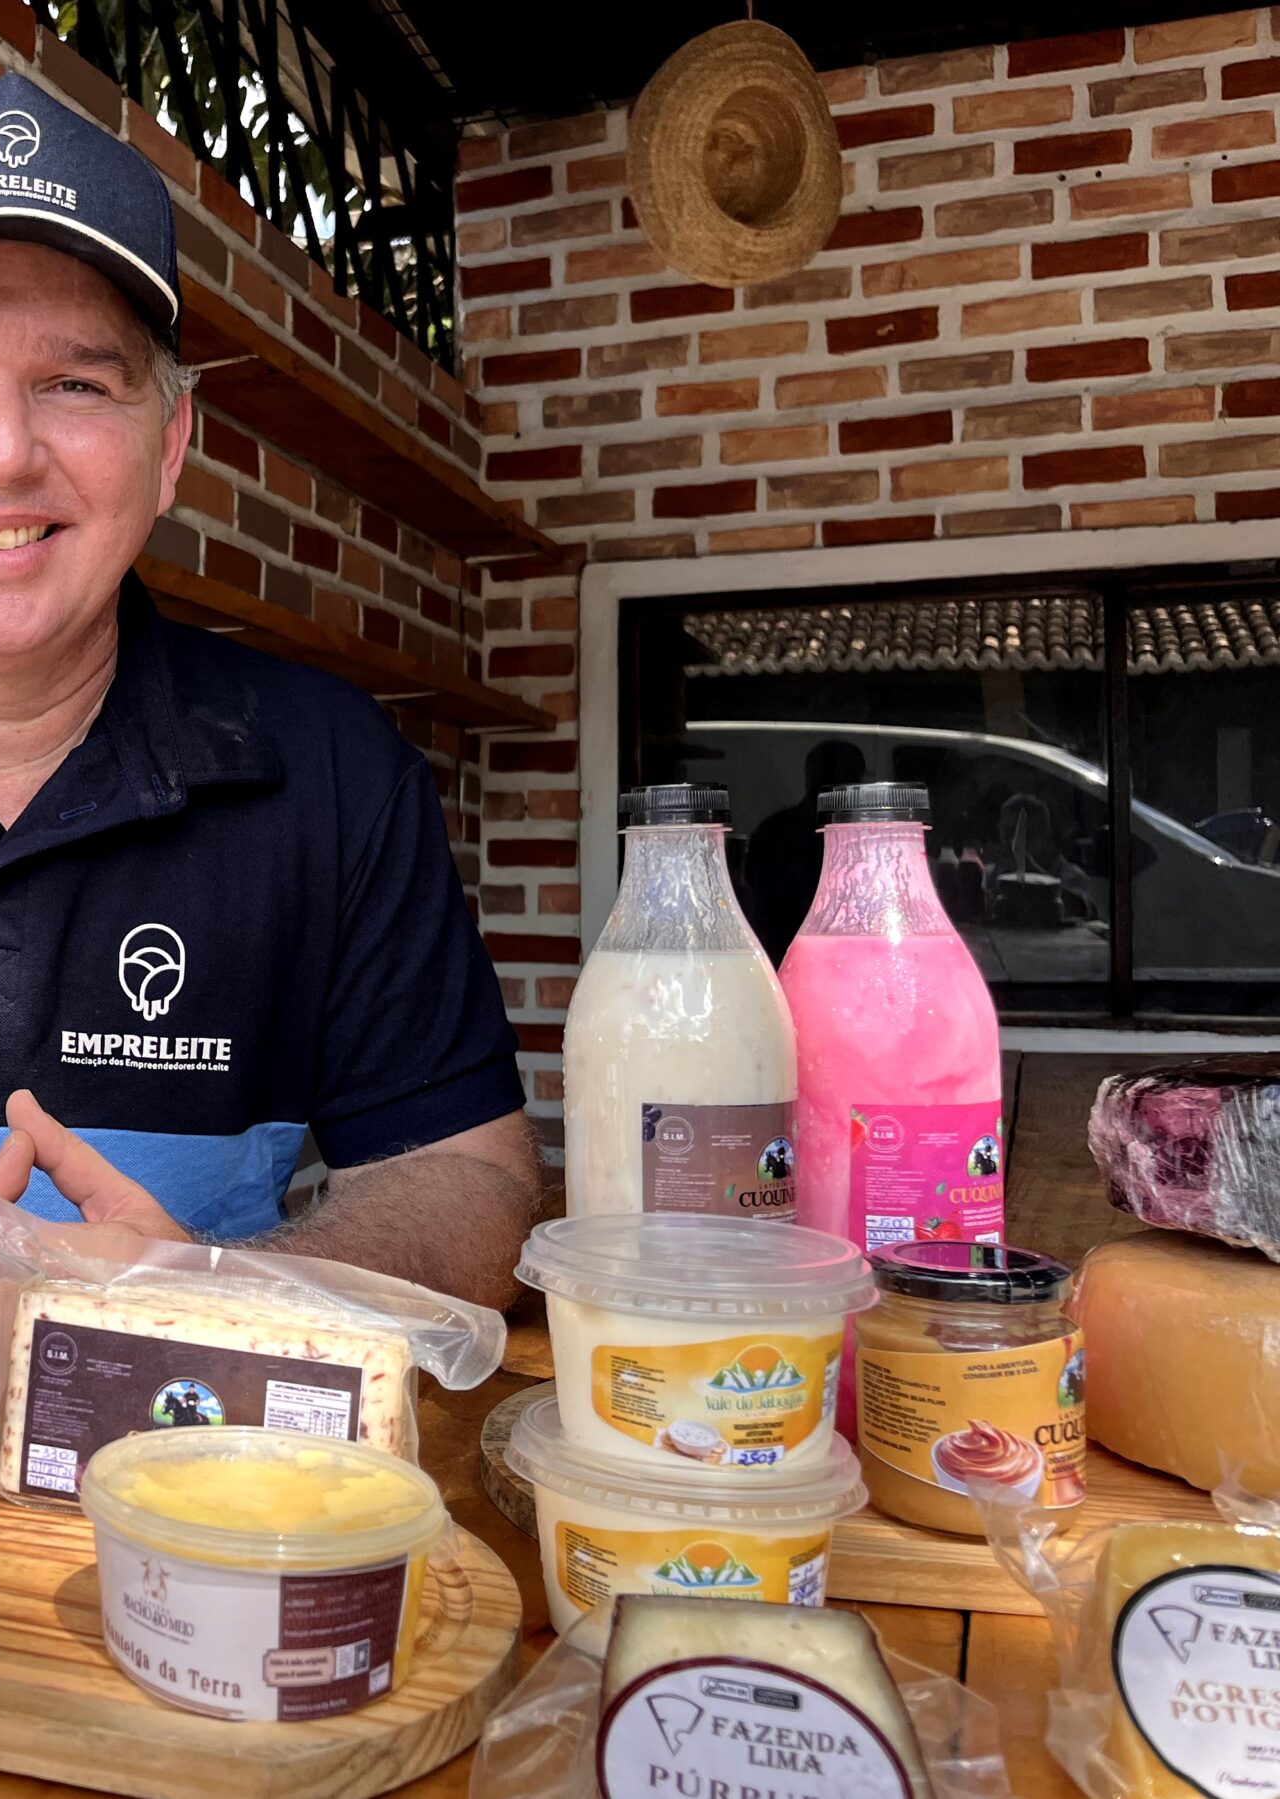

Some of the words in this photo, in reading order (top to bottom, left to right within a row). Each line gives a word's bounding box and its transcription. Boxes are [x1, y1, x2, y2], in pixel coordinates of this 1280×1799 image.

[61, 1031, 232, 1060] EMPRELEITE
[61, 1055, 107, 1067] Associação
[109, 1057, 124, 1066] dos
[125, 1059, 195, 1070] Empreendedores
[196, 1062, 207, 1071] de
[208, 1063, 229, 1072] Leite
[705, 1395, 731, 1410] Vale
[736, 1396, 753, 1410] do
[1247, 1649, 1280, 1671] LI
[159, 1658, 178, 1683] da
[188, 1668, 242, 1699] Terra
[1170, 1701, 1280, 1731] POTIG
[710, 1715, 861, 1757] FAZENDA
[748, 1744, 824, 1776] LIMA
